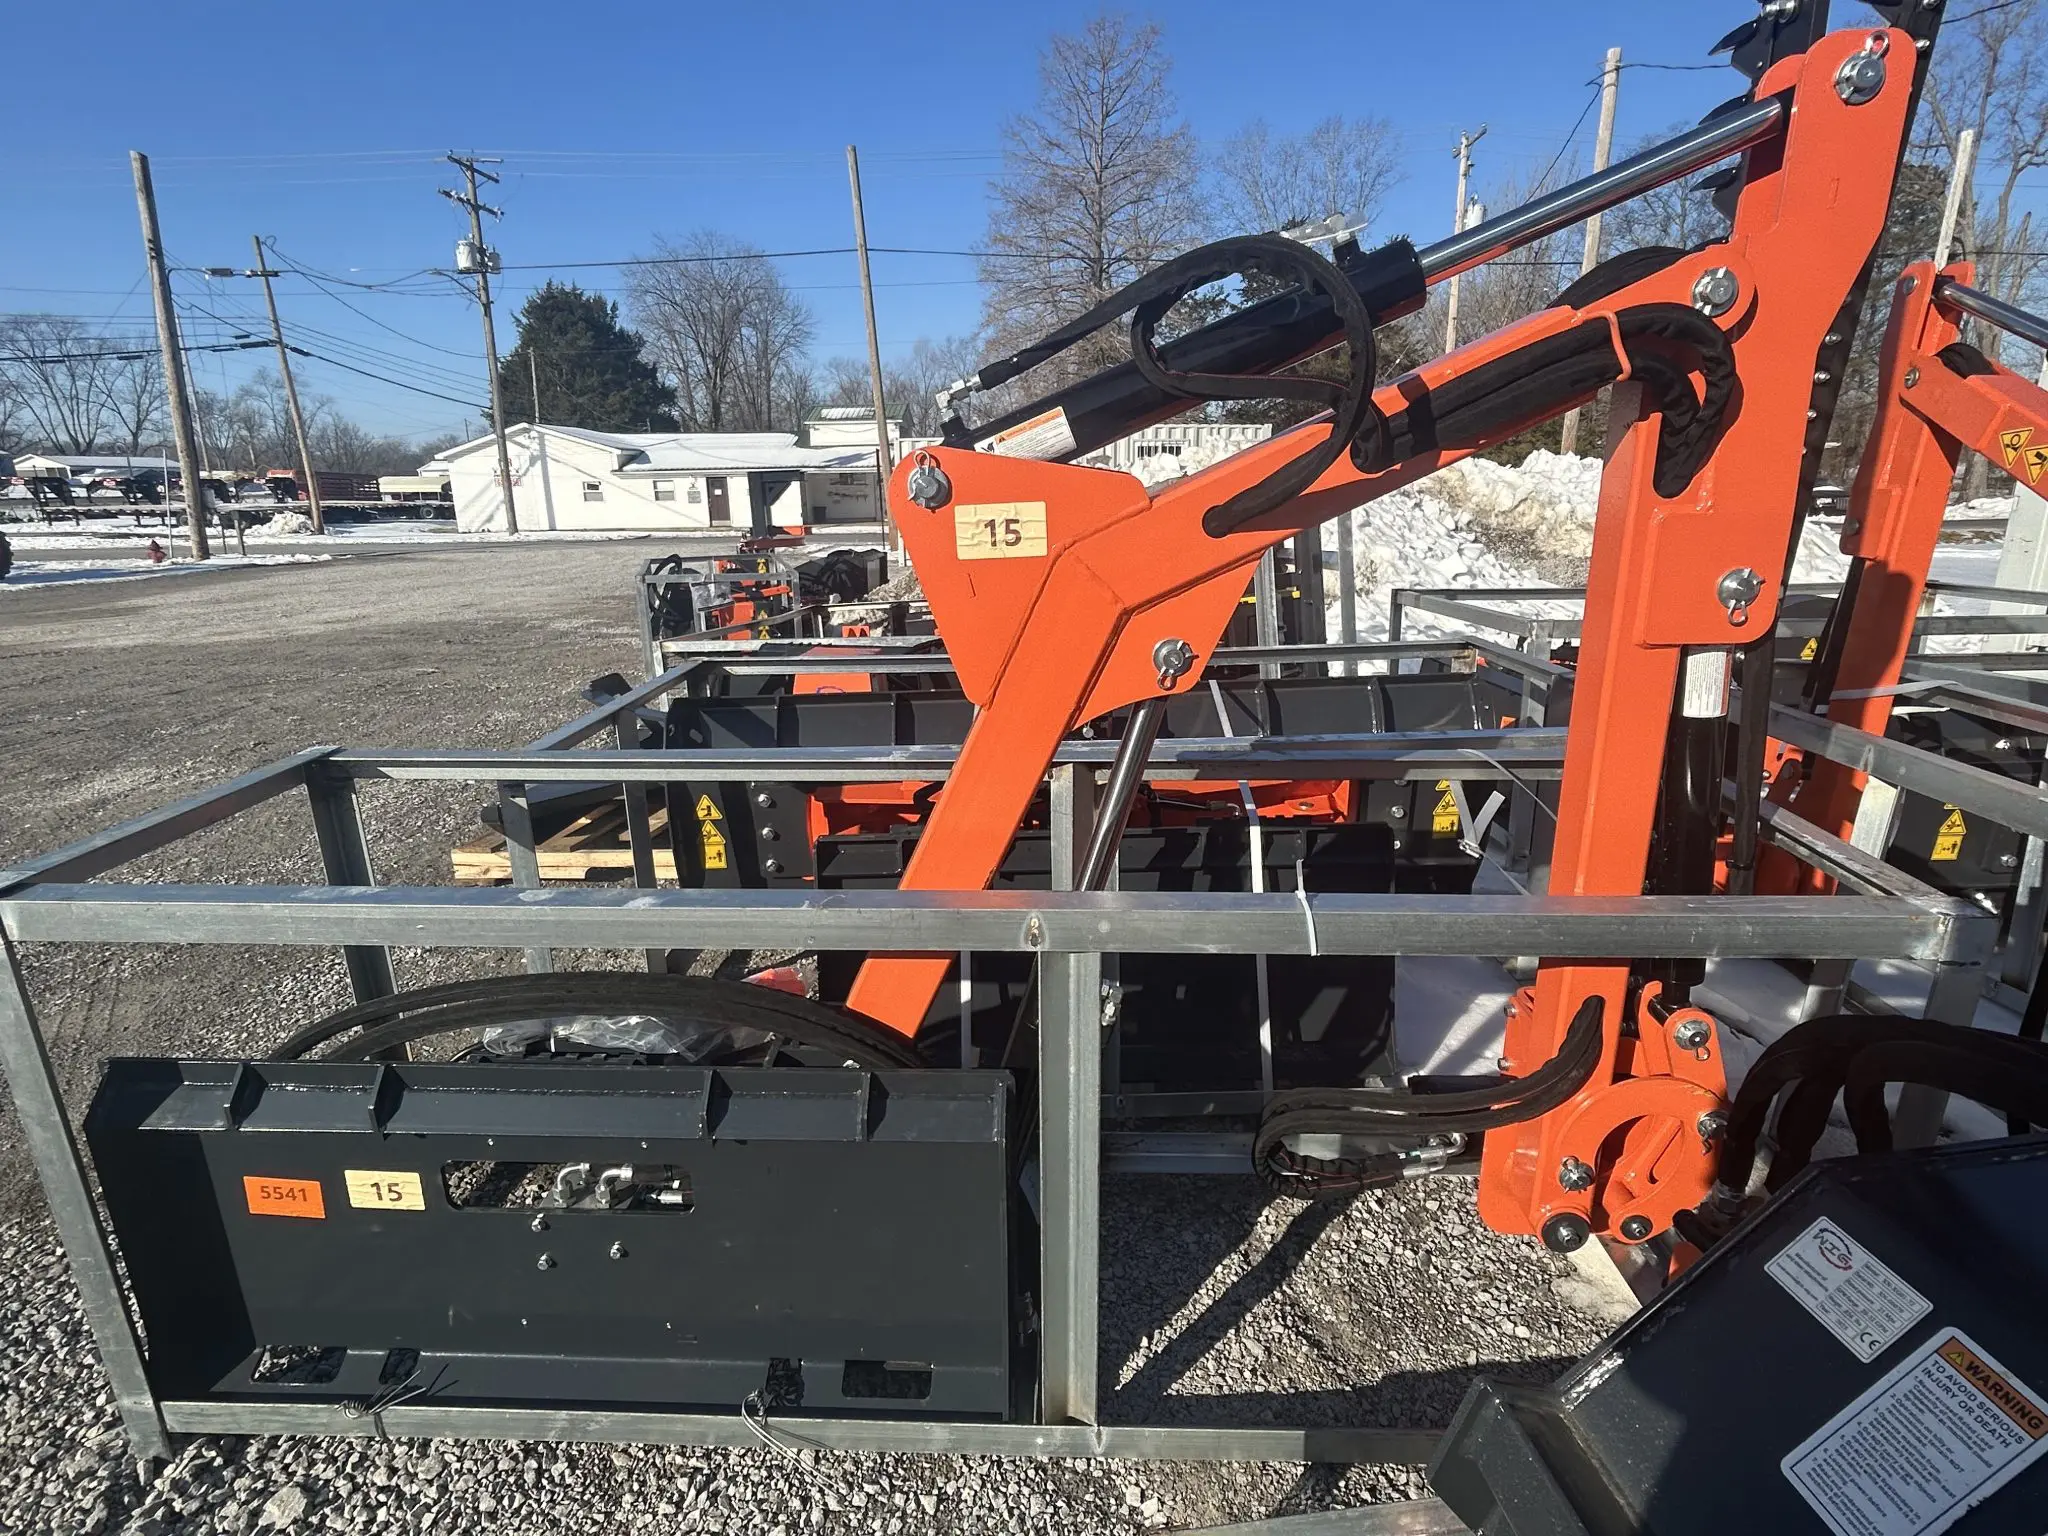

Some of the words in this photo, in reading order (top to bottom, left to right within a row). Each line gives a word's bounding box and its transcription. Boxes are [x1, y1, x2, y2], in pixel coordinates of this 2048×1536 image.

[984, 519, 1022, 547] 15
[260, 1185, 308, 1202] 5541
[370, 1182, 403, 1202] 15
[1921, 1367, 1958, 1399] INJURY
[1957, 1399, 1975, 1415] OR
[1974, 1415, 2011, 1447] DEATH
[1930, 1360, 1946, 1374] TO
[1944, 1373, 1977, 1401] AVOID
[1976, 1401, 2025, 1444] SERIOUS
[1964, 1362, 2044, 1429] WARNING
[1948, 1458, 1964, 1473] NOT
